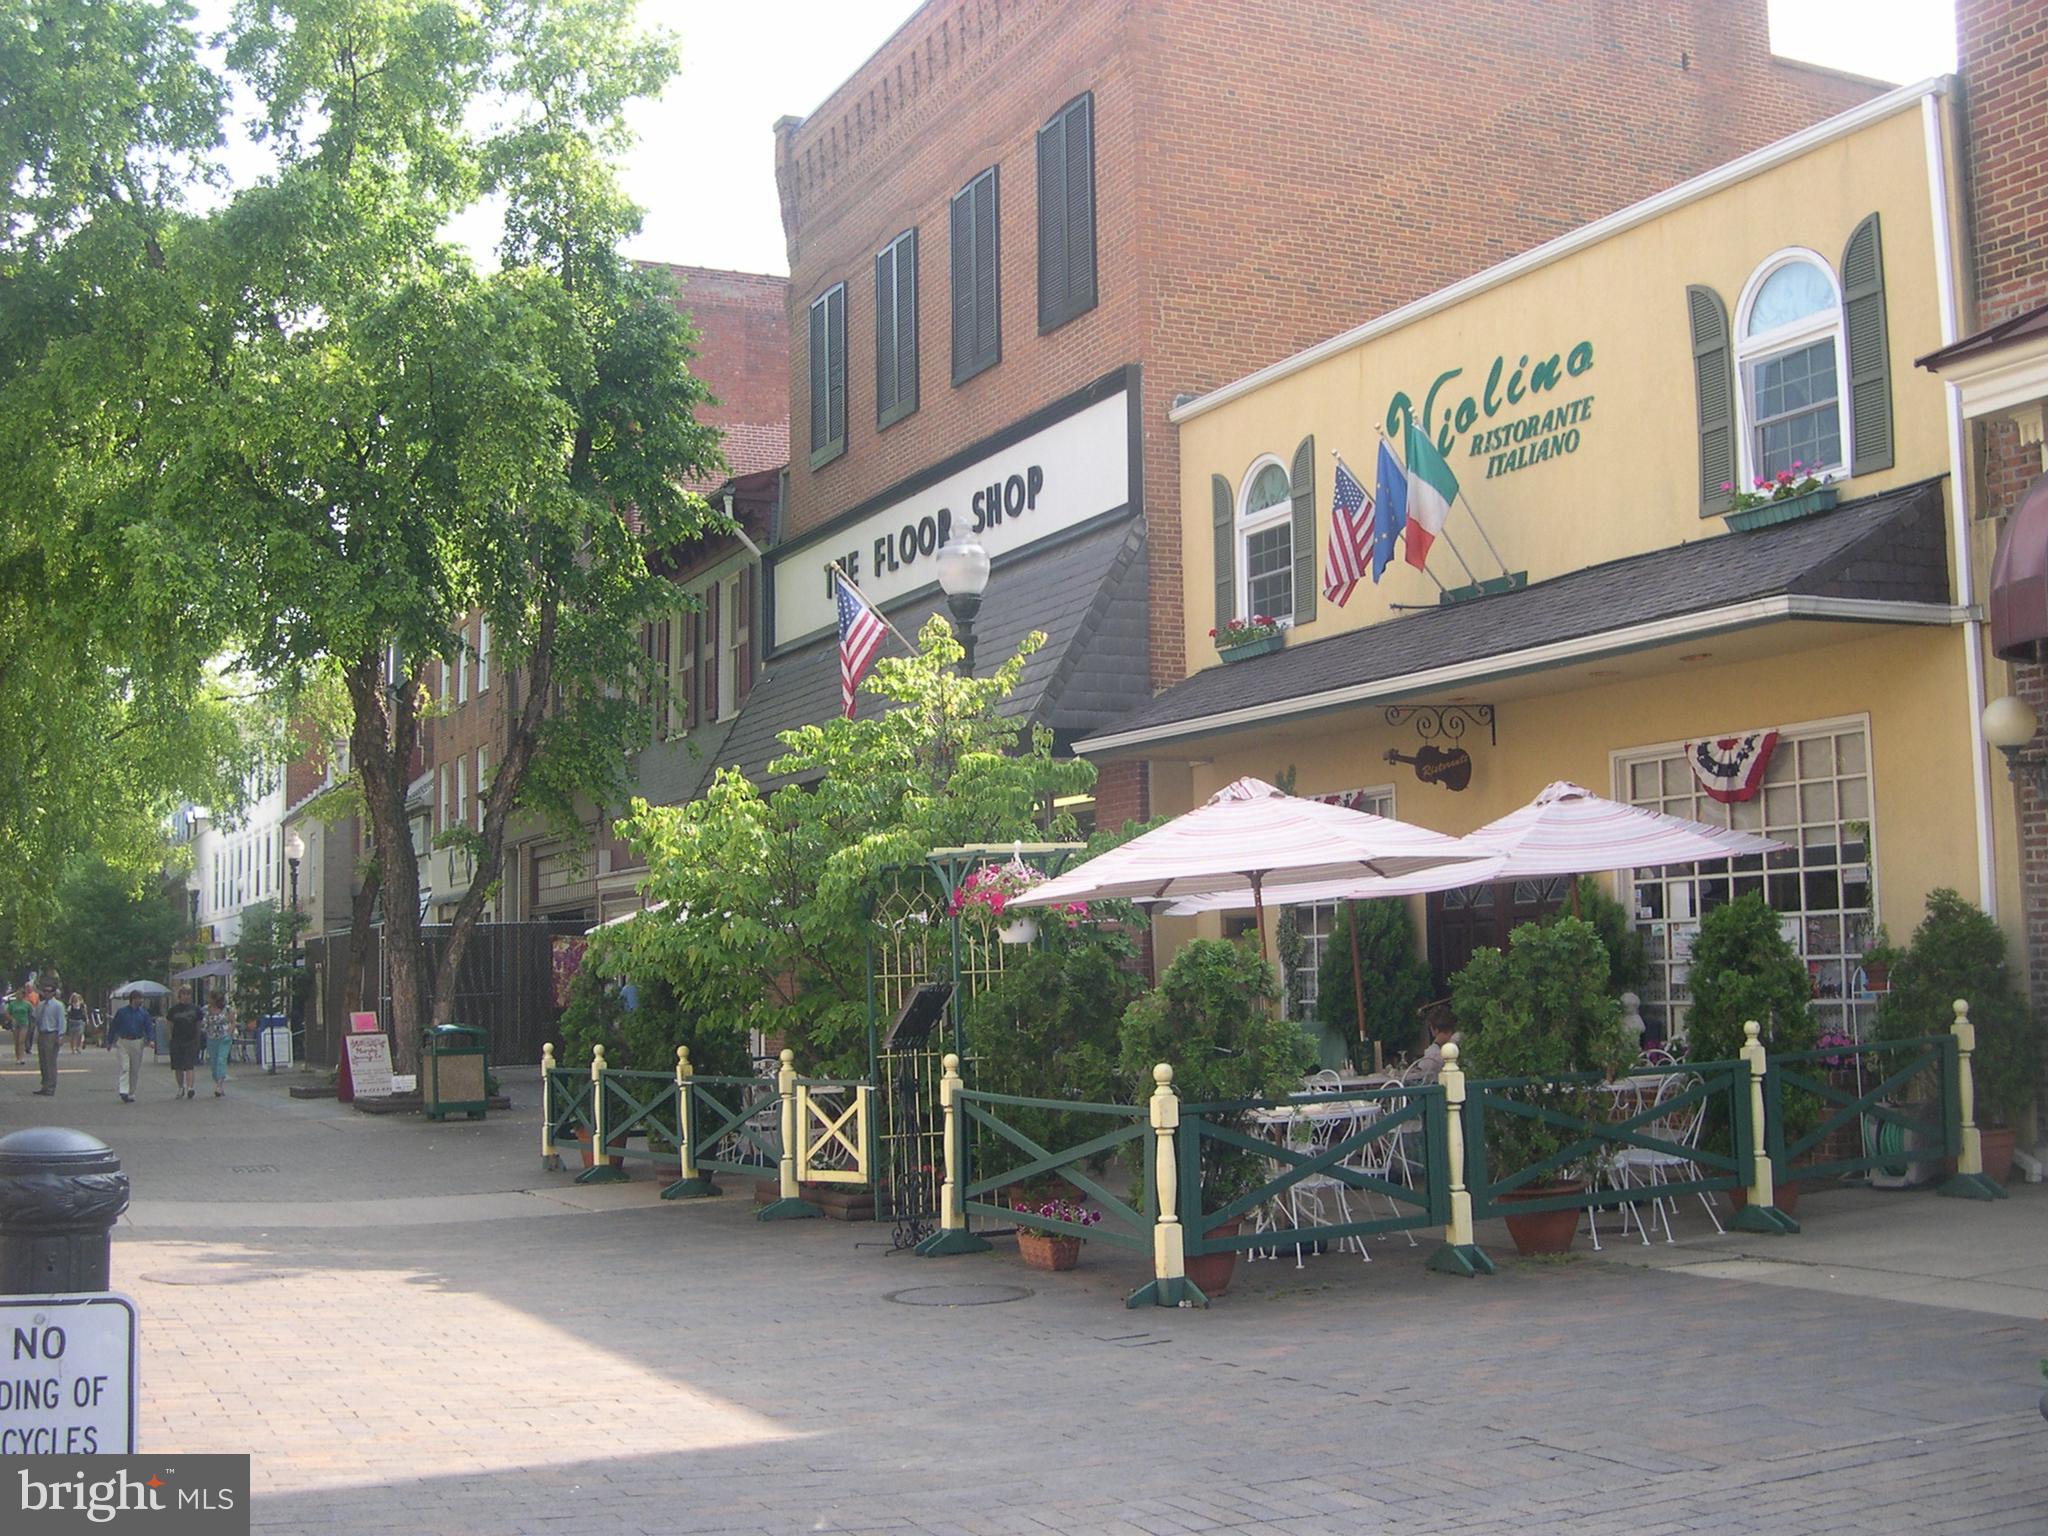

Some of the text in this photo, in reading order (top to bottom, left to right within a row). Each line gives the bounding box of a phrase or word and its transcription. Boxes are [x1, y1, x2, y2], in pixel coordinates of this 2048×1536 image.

[1387, 341, 1593, 465] Violino
[1469, 395, 1595, 456] RISTORANTE
[1486, 429, 1580, 479] ITALIANO
[874, 508, 952, 577] FLOOR
[972, 465, 1044, 533] SHOP
[13, 1326, 66, 1359] NO
[0, 1376, 108, 1410] DING OF
[2, 1426, 98, 1454] CYCLES
